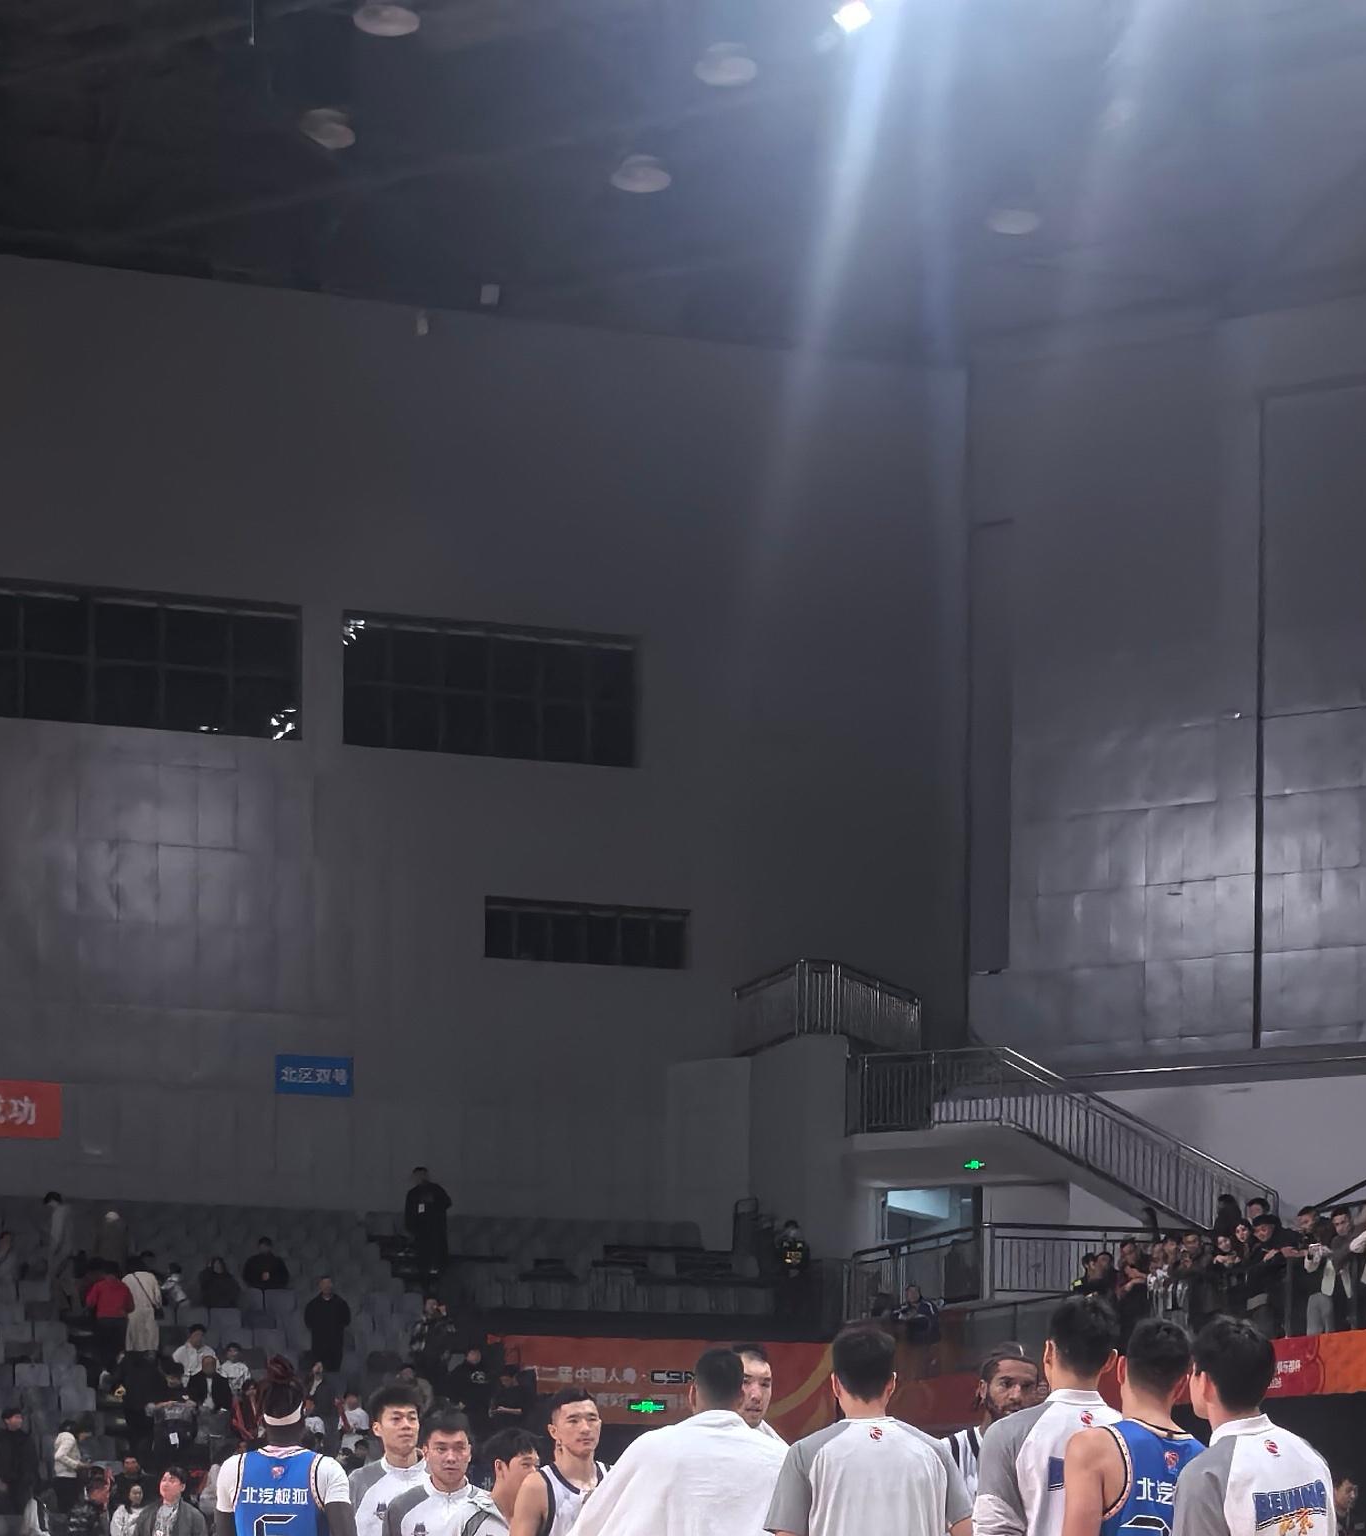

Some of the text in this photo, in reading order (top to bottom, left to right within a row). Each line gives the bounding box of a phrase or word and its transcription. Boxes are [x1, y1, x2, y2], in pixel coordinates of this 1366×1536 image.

[241, 1486, 309, 1505] 北汽极狐
[1136, 1477, 1174, 1505] 北汽
